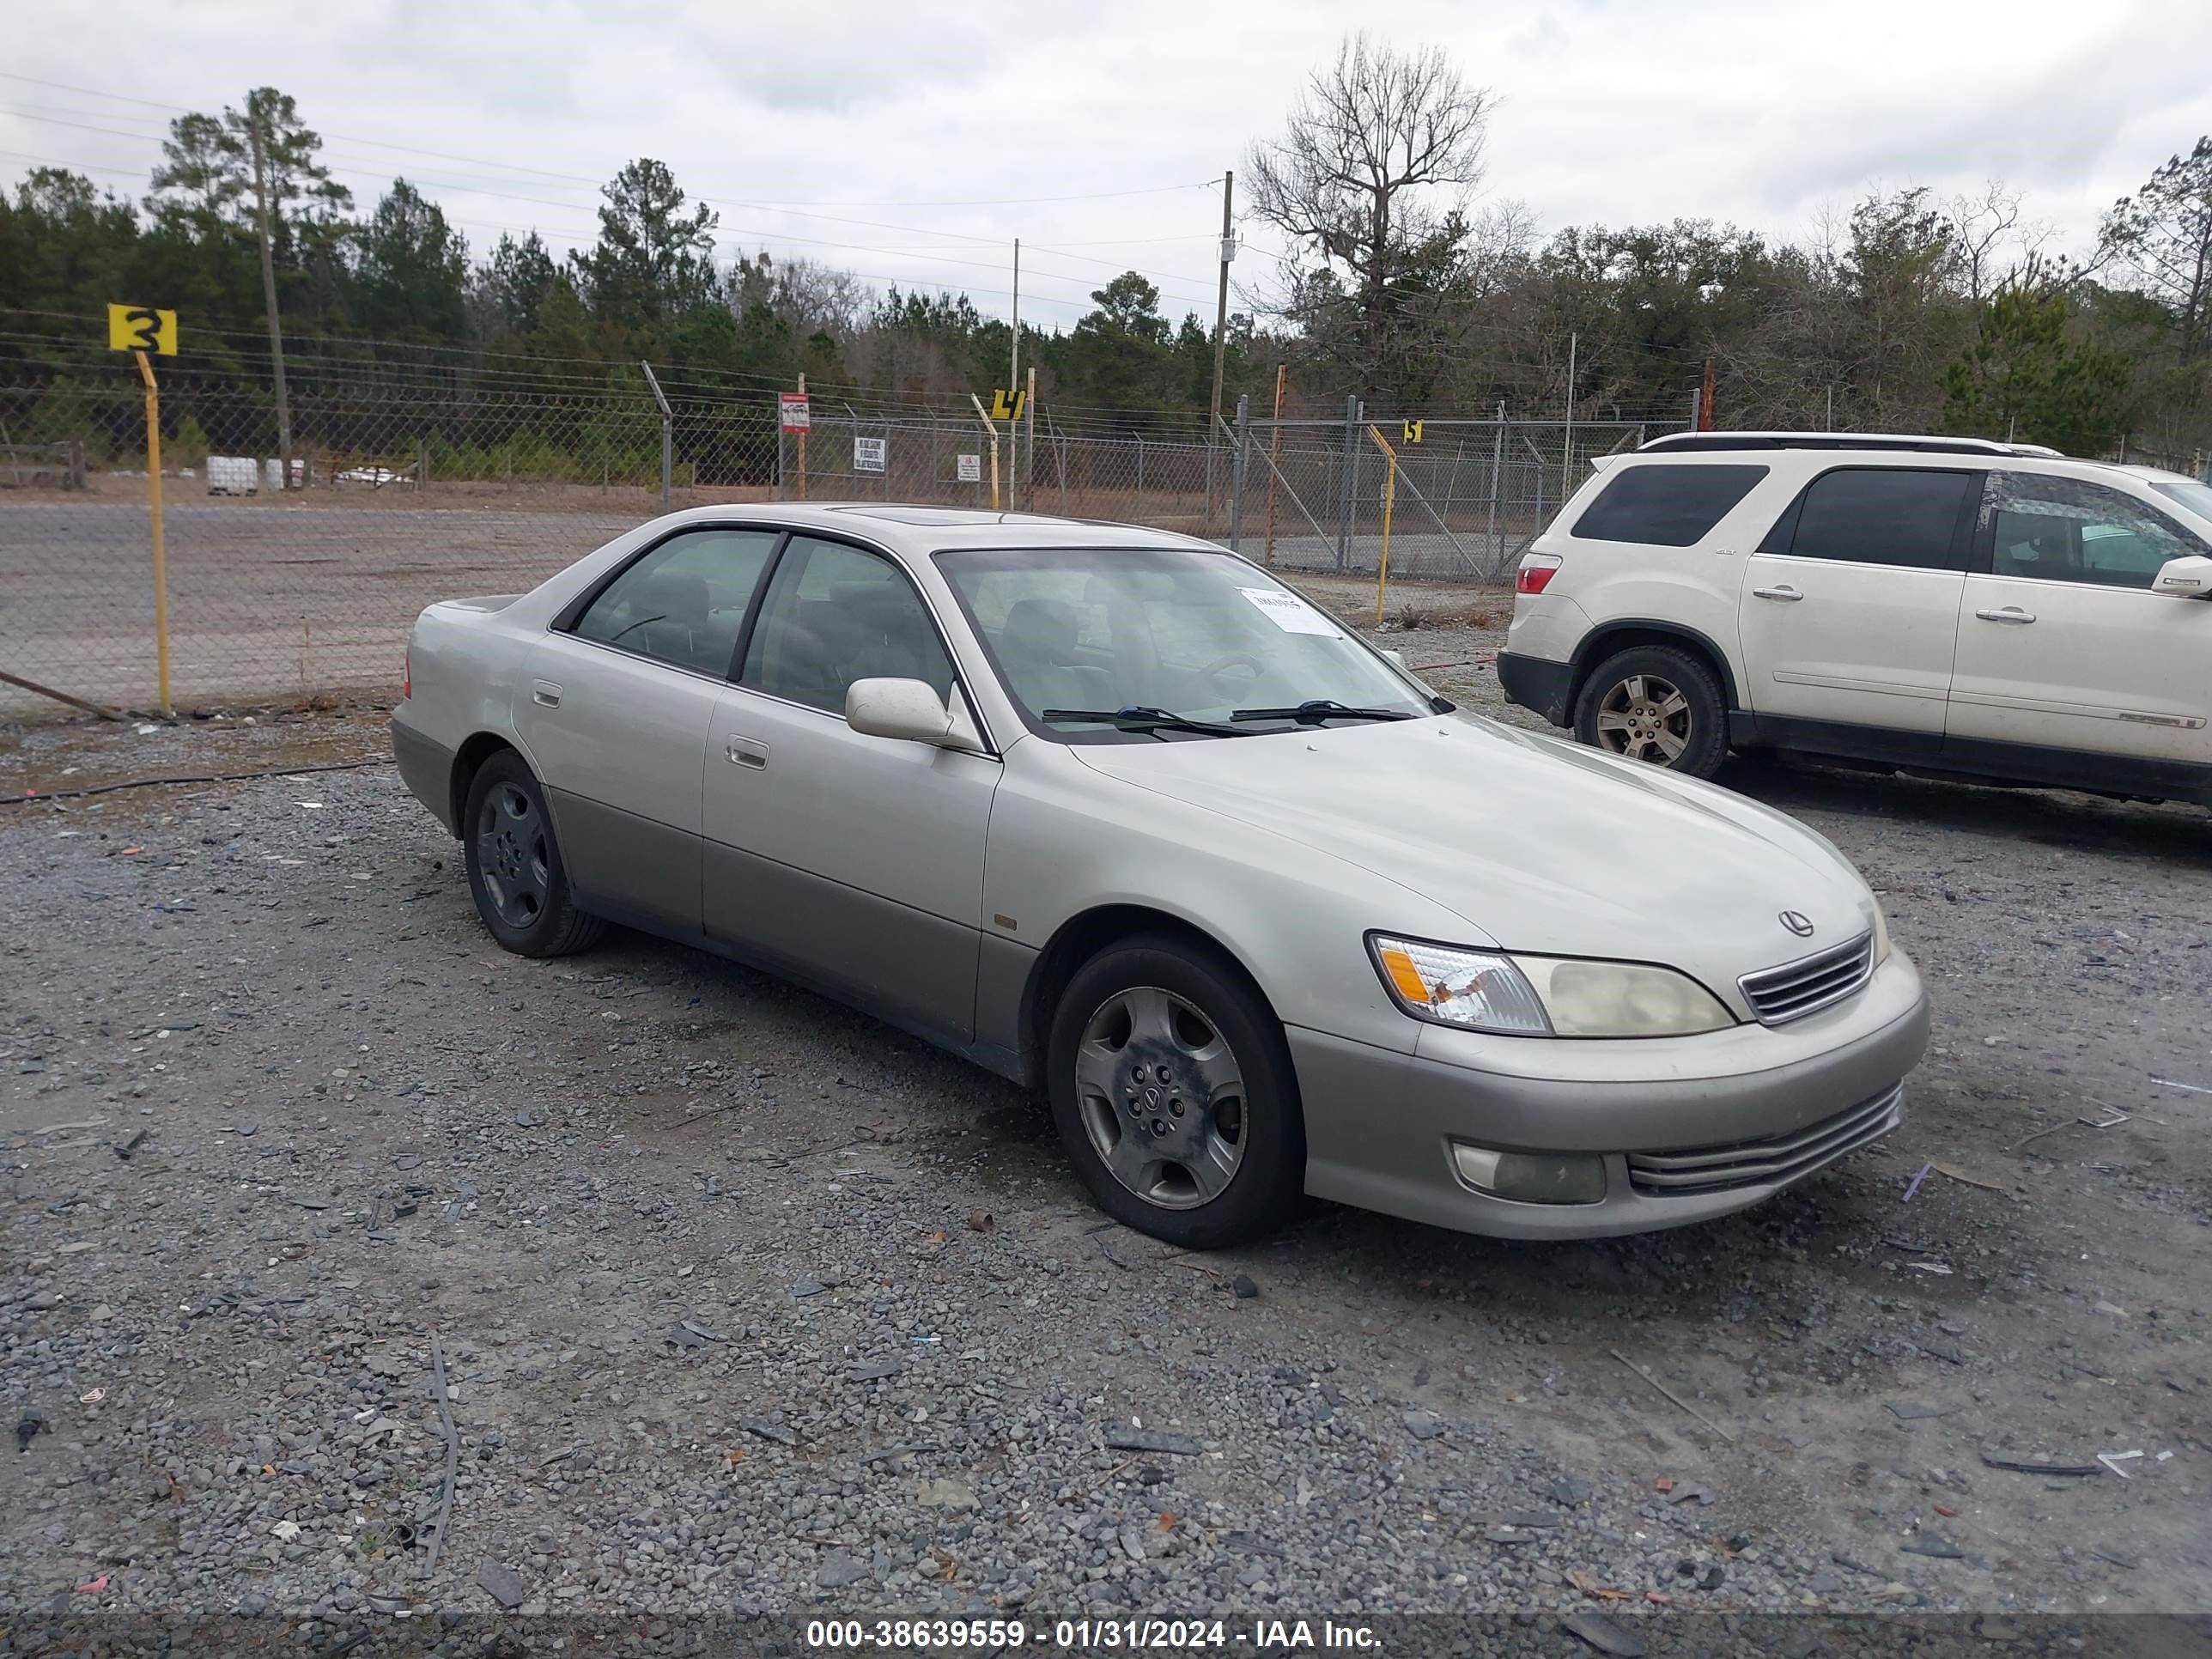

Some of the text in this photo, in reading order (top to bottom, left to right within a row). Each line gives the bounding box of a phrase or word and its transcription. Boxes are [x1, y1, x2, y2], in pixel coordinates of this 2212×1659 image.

[125, 309, 162, 352] 3
[1002, 390, 1020, 419] 4
[1407, 420, 1418, 441] 5
